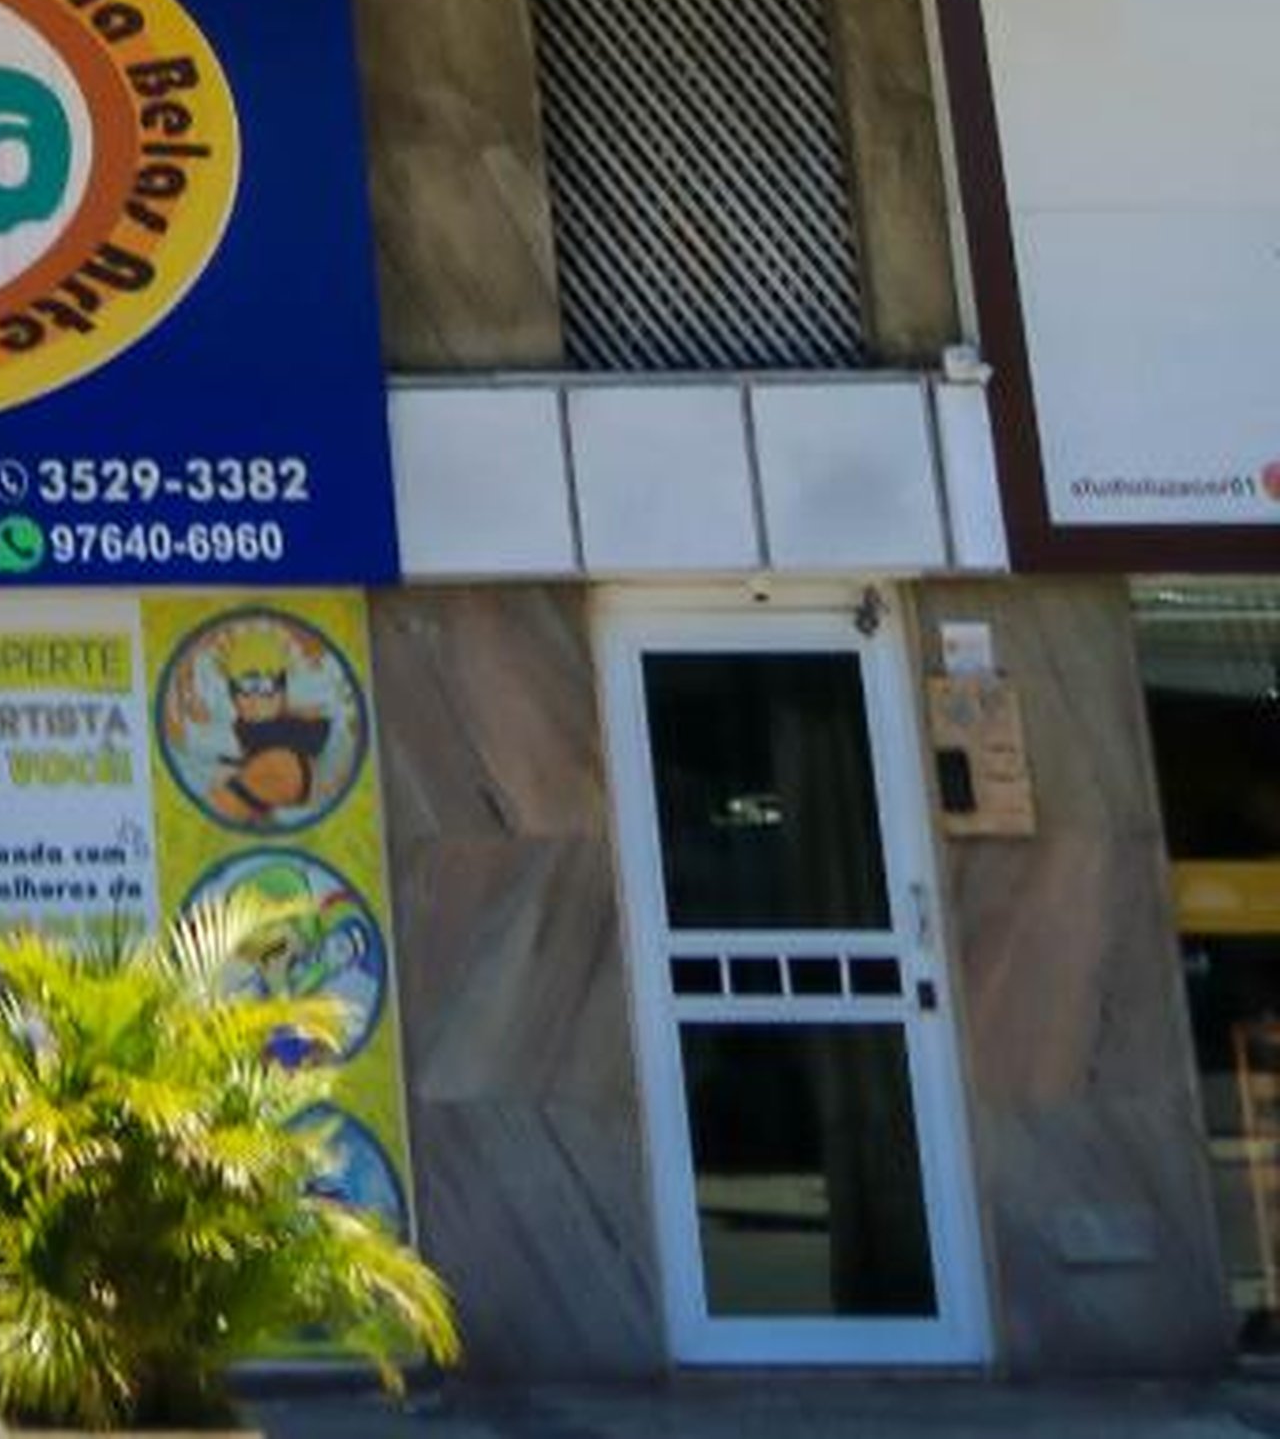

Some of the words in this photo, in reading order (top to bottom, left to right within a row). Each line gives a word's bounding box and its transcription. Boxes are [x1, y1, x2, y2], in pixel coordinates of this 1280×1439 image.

[126, 56, 212, 235] Belas
[38, 458, 309, 503] 3529-3382
[50, 521, 283, 563] 97640-6960
[72, 843, 127, 865] com
